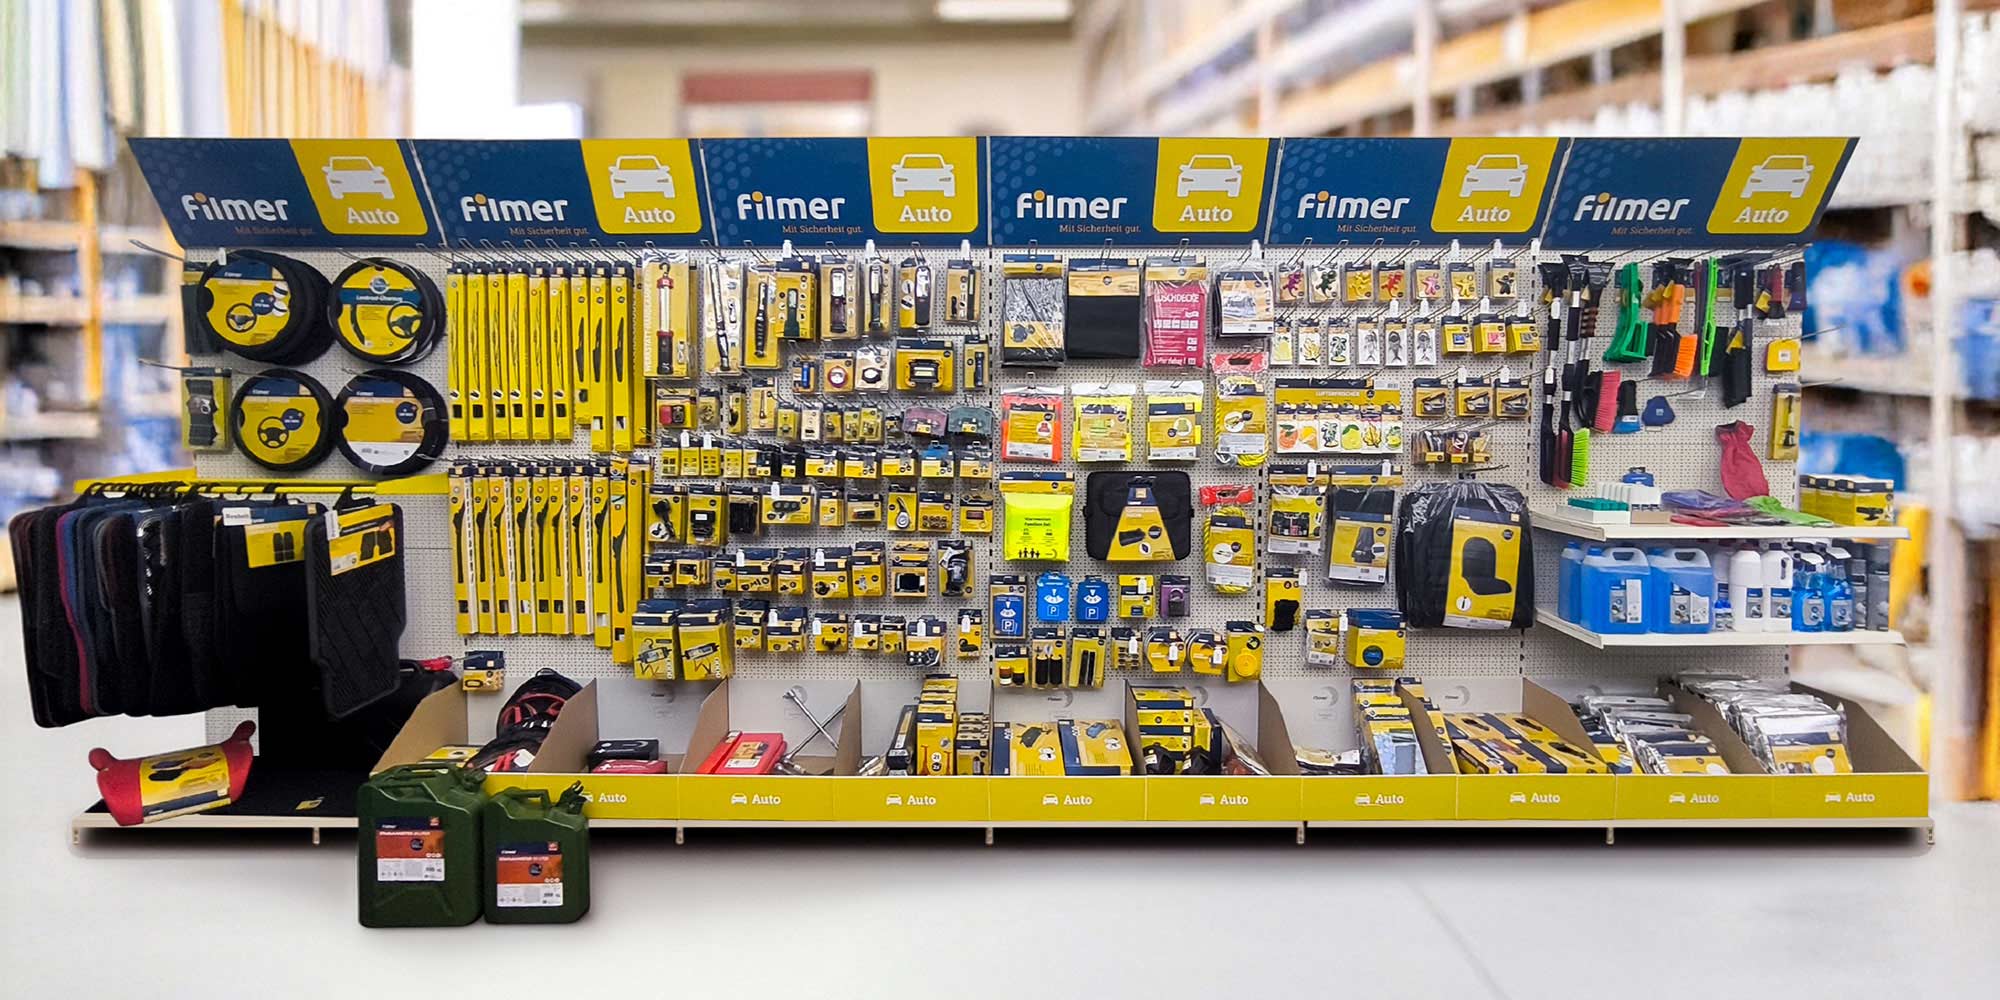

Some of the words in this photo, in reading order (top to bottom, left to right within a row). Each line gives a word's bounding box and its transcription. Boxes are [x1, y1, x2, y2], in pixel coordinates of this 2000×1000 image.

[347, 207, 400, 225] Auto
[624, 206, 676, 224] Auto
[899, 205, 952, 223] Auto
[1179, 205, 1233, 222] Auto
[1457, 205, 1511, 223] Auto
[1733, 206, 1790, 224] Auto
[1059, 224, 1075, 233] Mit
[1077, 223, 1124, 233] Sicherheit
[599, 793, 627, 803] Auto
[752, 794, 781, 804] Auto
[907, 795, 936, 805] Auto
[1064, 795, 1093, 805] Auto
[1220, 794, 1249, 805] Auto
[1375, 794, 1404, 804] Auto
[1531, 793, 1561, 803] Auto
[1690, 793, 1719, 804] Auto
[1846, 792, 1875, 802] Auto
